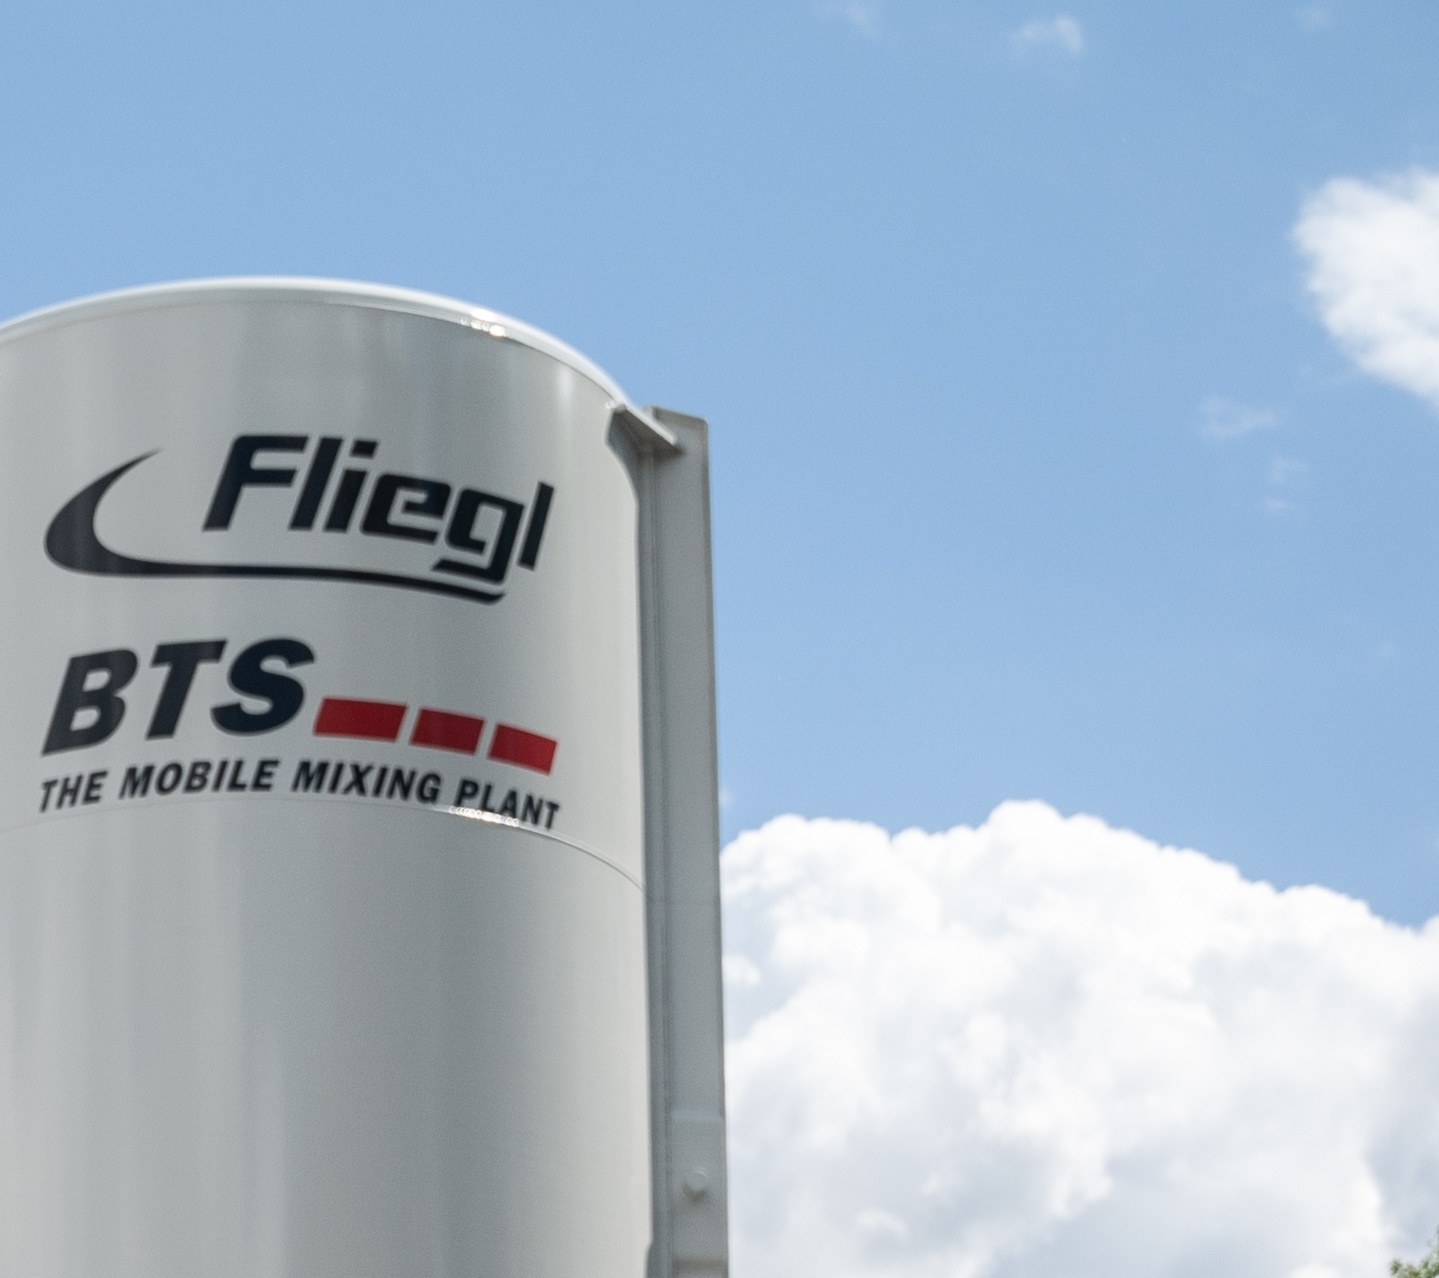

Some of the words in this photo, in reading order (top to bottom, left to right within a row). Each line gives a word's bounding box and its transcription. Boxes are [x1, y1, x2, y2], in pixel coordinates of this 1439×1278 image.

[202, 433, 555, 583] Fliegl
[41, 636, 316, 756] BTS
[39, 769, 107, 812] THE
[120, 757, 281, 799] MOBILE
[291, 757, 443, 807] MIXING
[454, 778, 562, 830] PLANT
